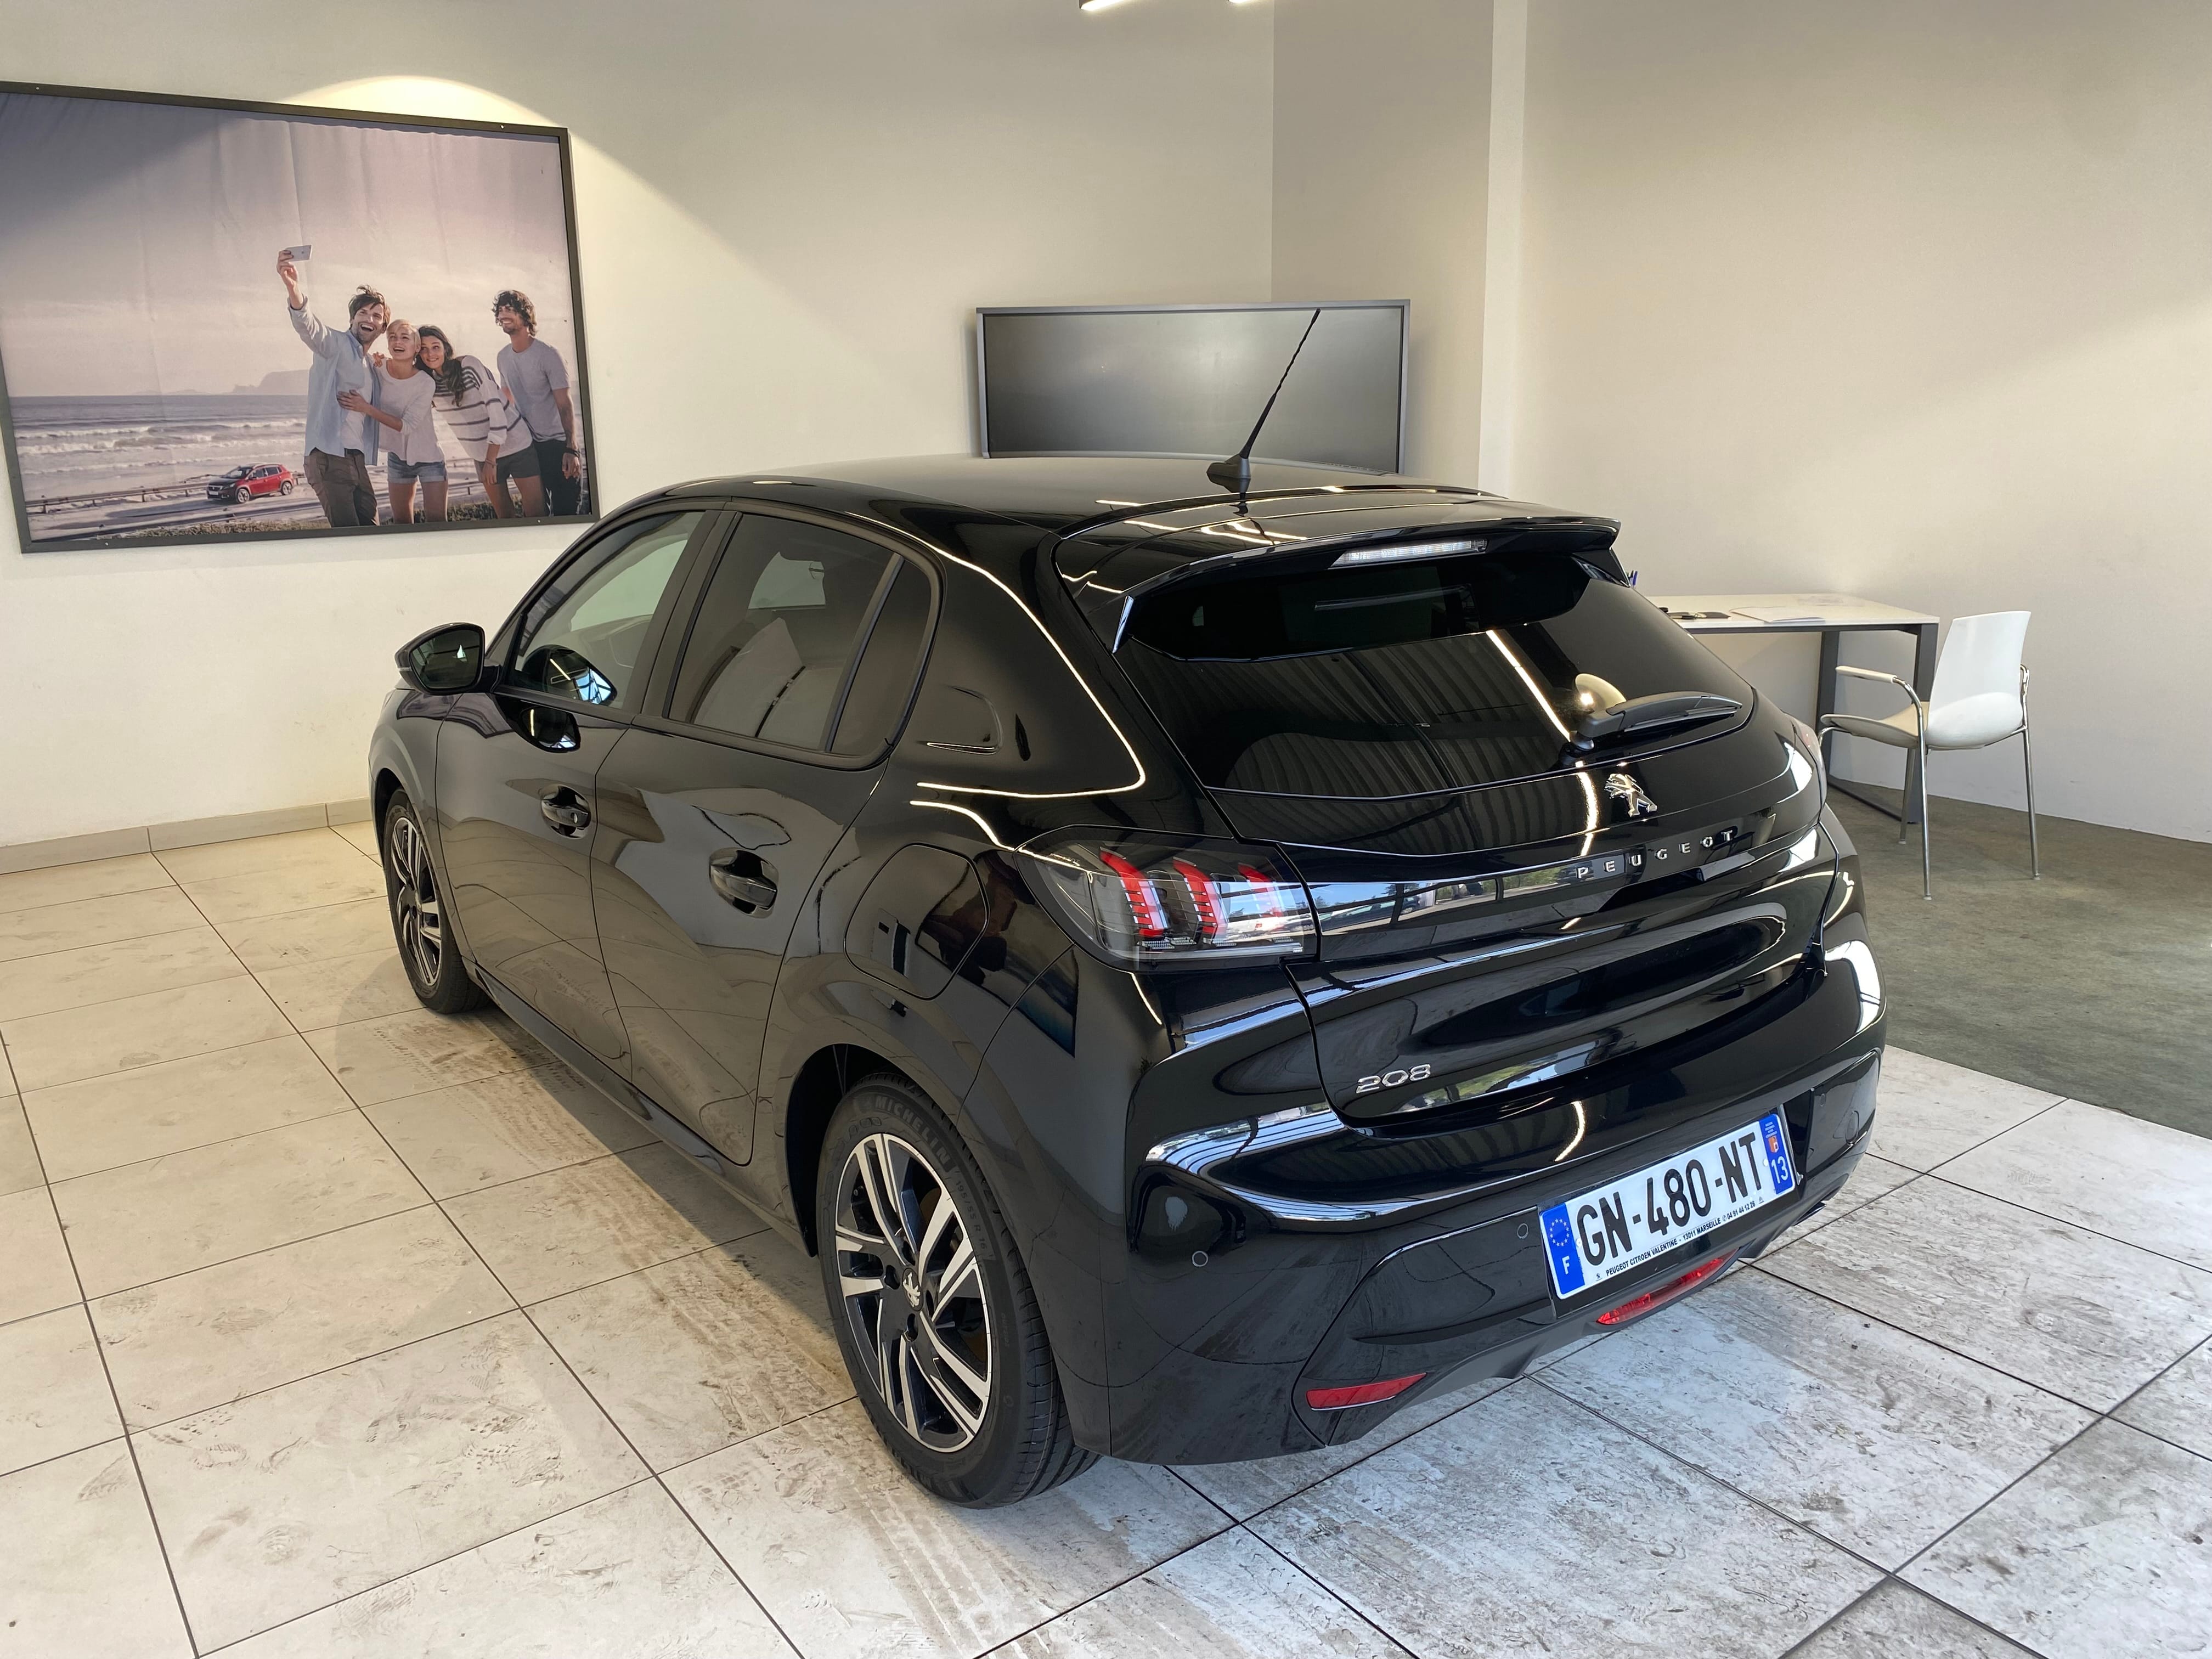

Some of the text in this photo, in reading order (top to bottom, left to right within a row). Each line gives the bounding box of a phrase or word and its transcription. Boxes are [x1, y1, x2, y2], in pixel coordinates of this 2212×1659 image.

[1576, 830, 1733, 879] PEUGEOT
[1356, 1064, 1431, 1094] 208
[875, 1096, 951, 1165] MICHELIN
[1771, 1156, 1788, 1183] 13
[956, 1181, 977, 1219] 195/55
[979, 1238, 988, 1249] 16
[1577, 1132, 1762, 1266] GN-480-NT
[1562, 1256, 1571, 1274] F
[1606, 1261, 1629, 1276] PEUGEOT
[1629, 1252, 1651, 1266] CITROEN
[1651, 1239, 1677, 1255] VALENTINE
[1683, 1230, 1696, 1240] 13011
[1697, 1218, 1721, 1234] MARSEILLE
